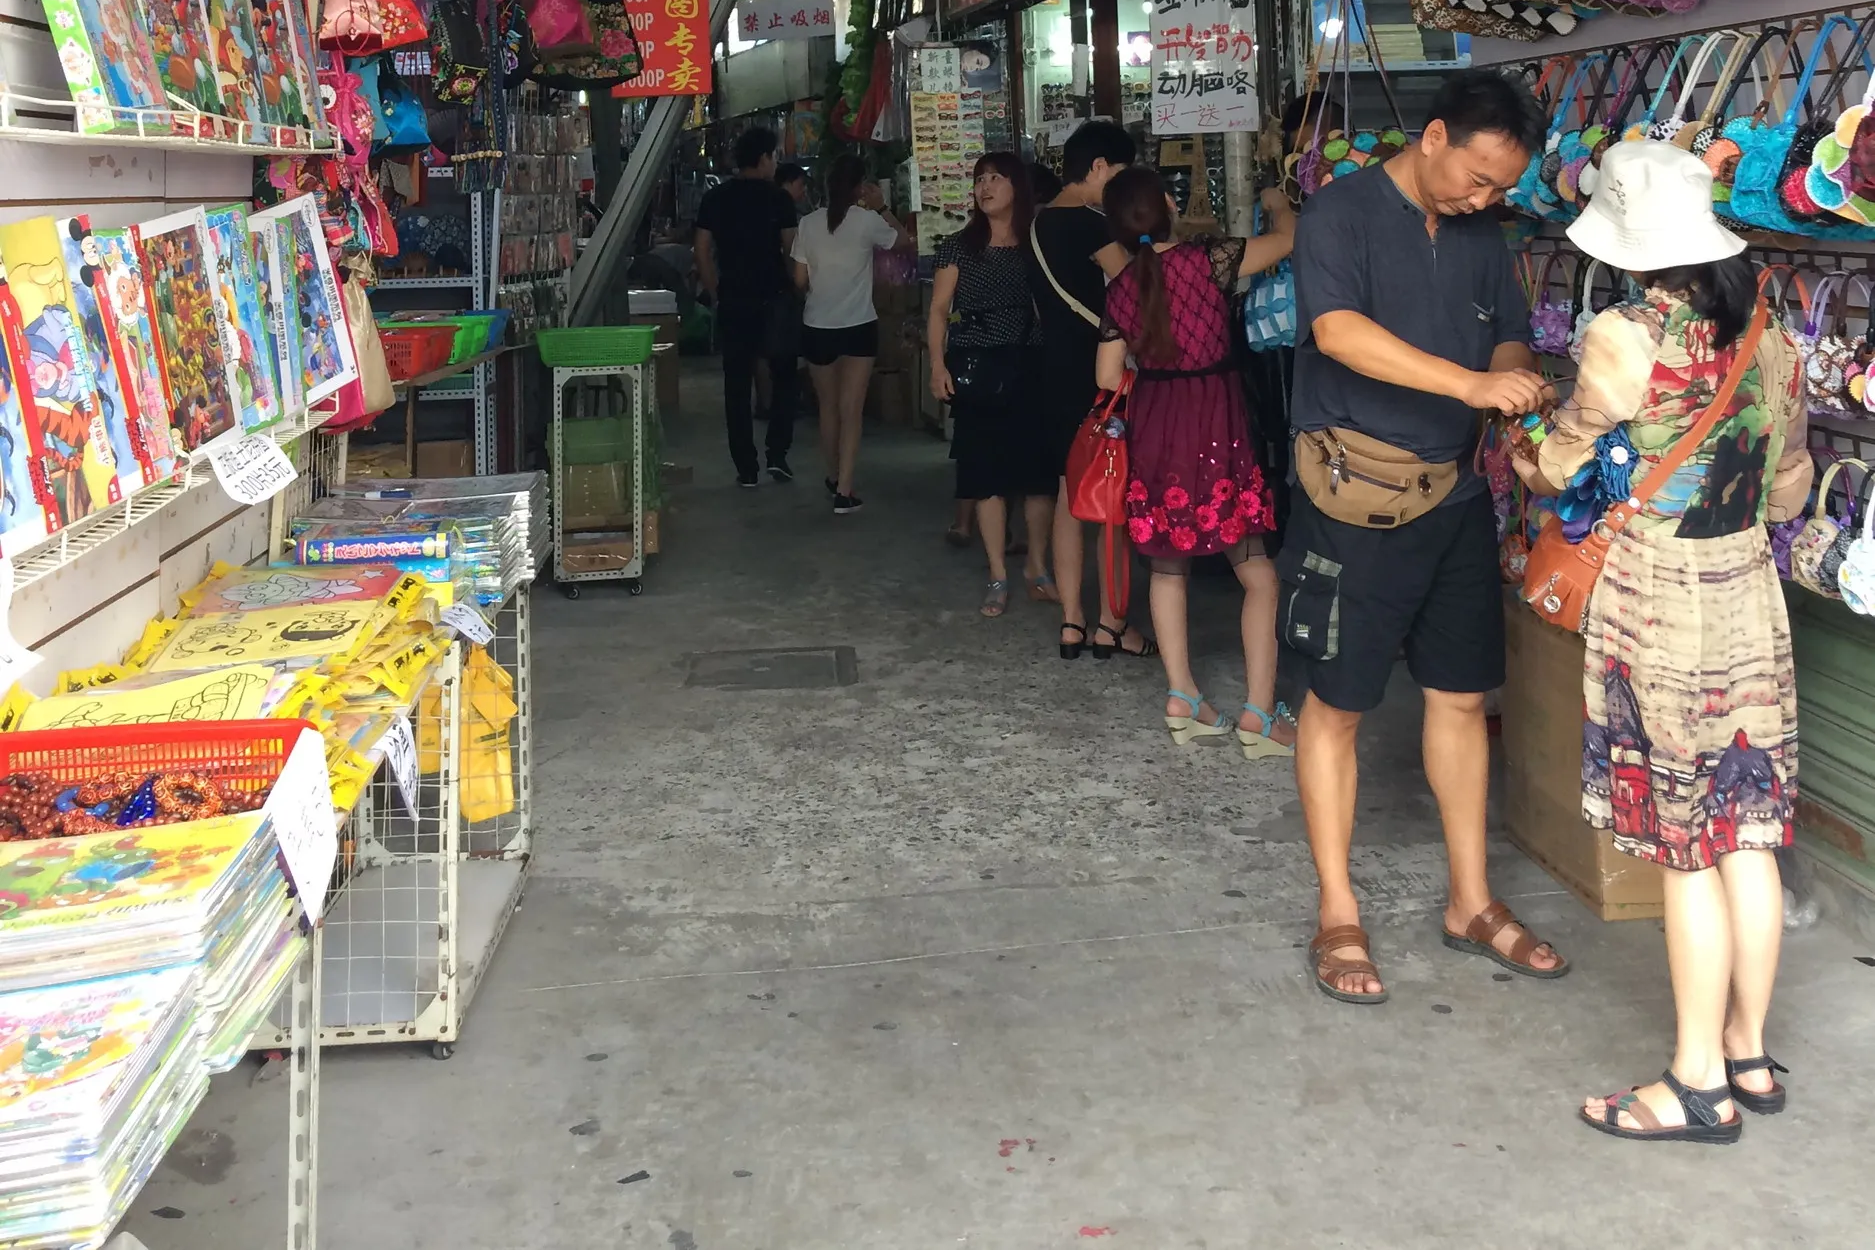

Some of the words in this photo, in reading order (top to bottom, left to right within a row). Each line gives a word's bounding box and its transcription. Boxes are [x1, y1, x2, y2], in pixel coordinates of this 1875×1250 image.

[629, 12, 654, 31] 00P
[744, 8, 830, 33] 禁止吸烟
[1155, 102, 1245, 129] 买一送一
